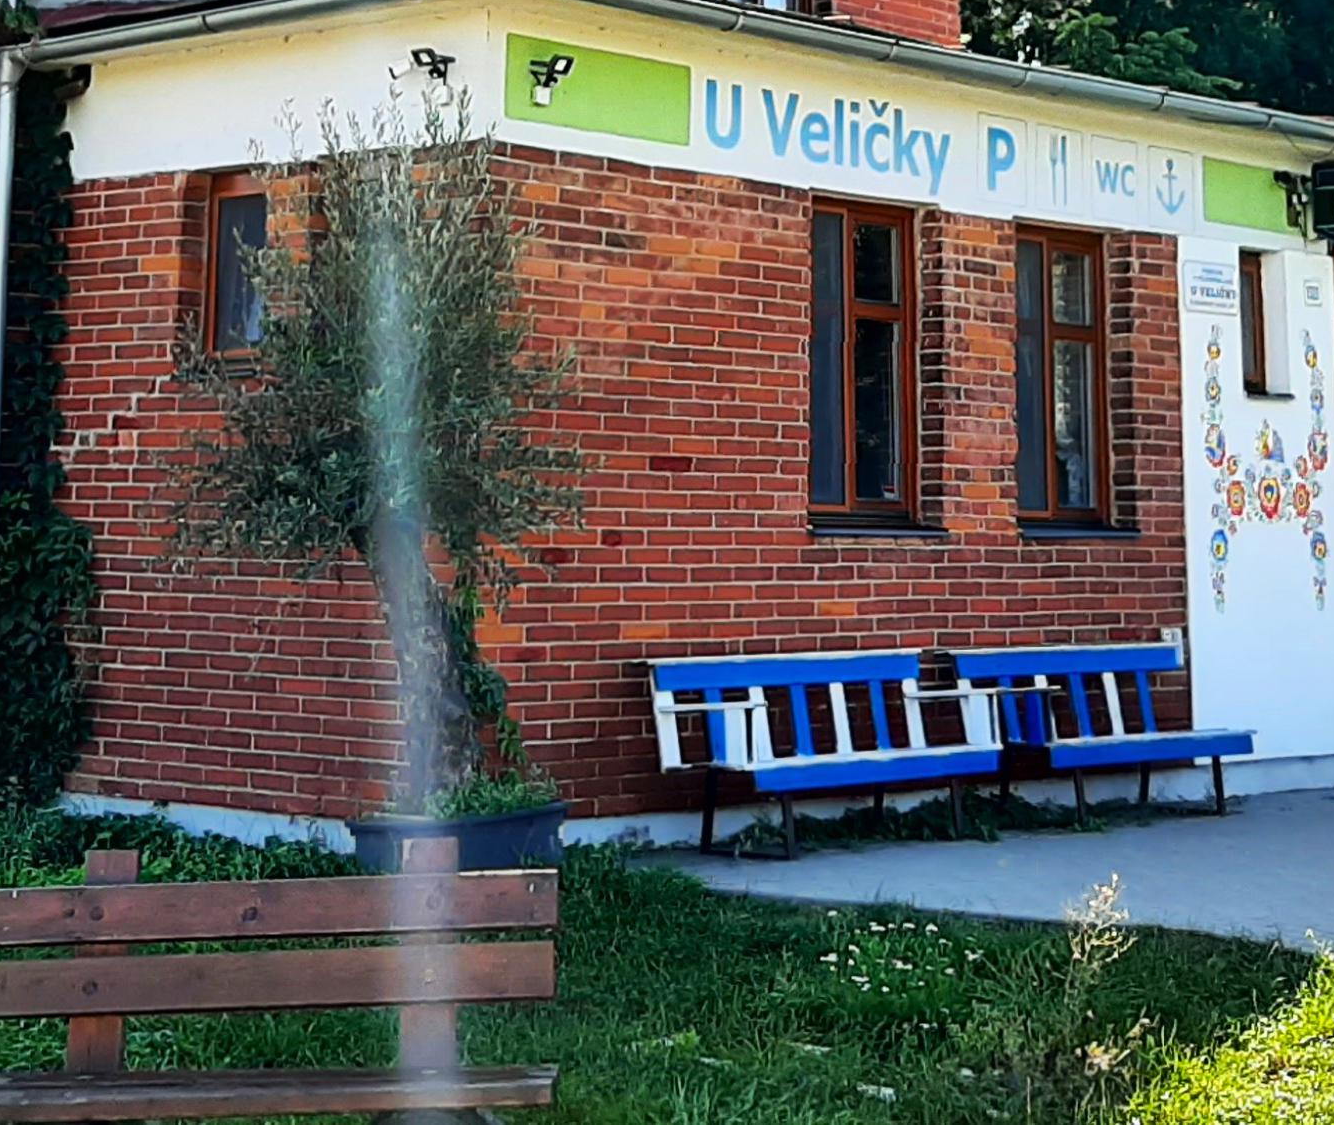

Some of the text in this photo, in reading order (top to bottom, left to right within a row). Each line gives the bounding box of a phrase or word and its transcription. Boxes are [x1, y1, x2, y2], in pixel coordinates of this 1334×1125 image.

[704, 79, 952, 197] U Veličky
[986, 126, 1017, 192] P
[1094, 159, 1137, 197] WC
